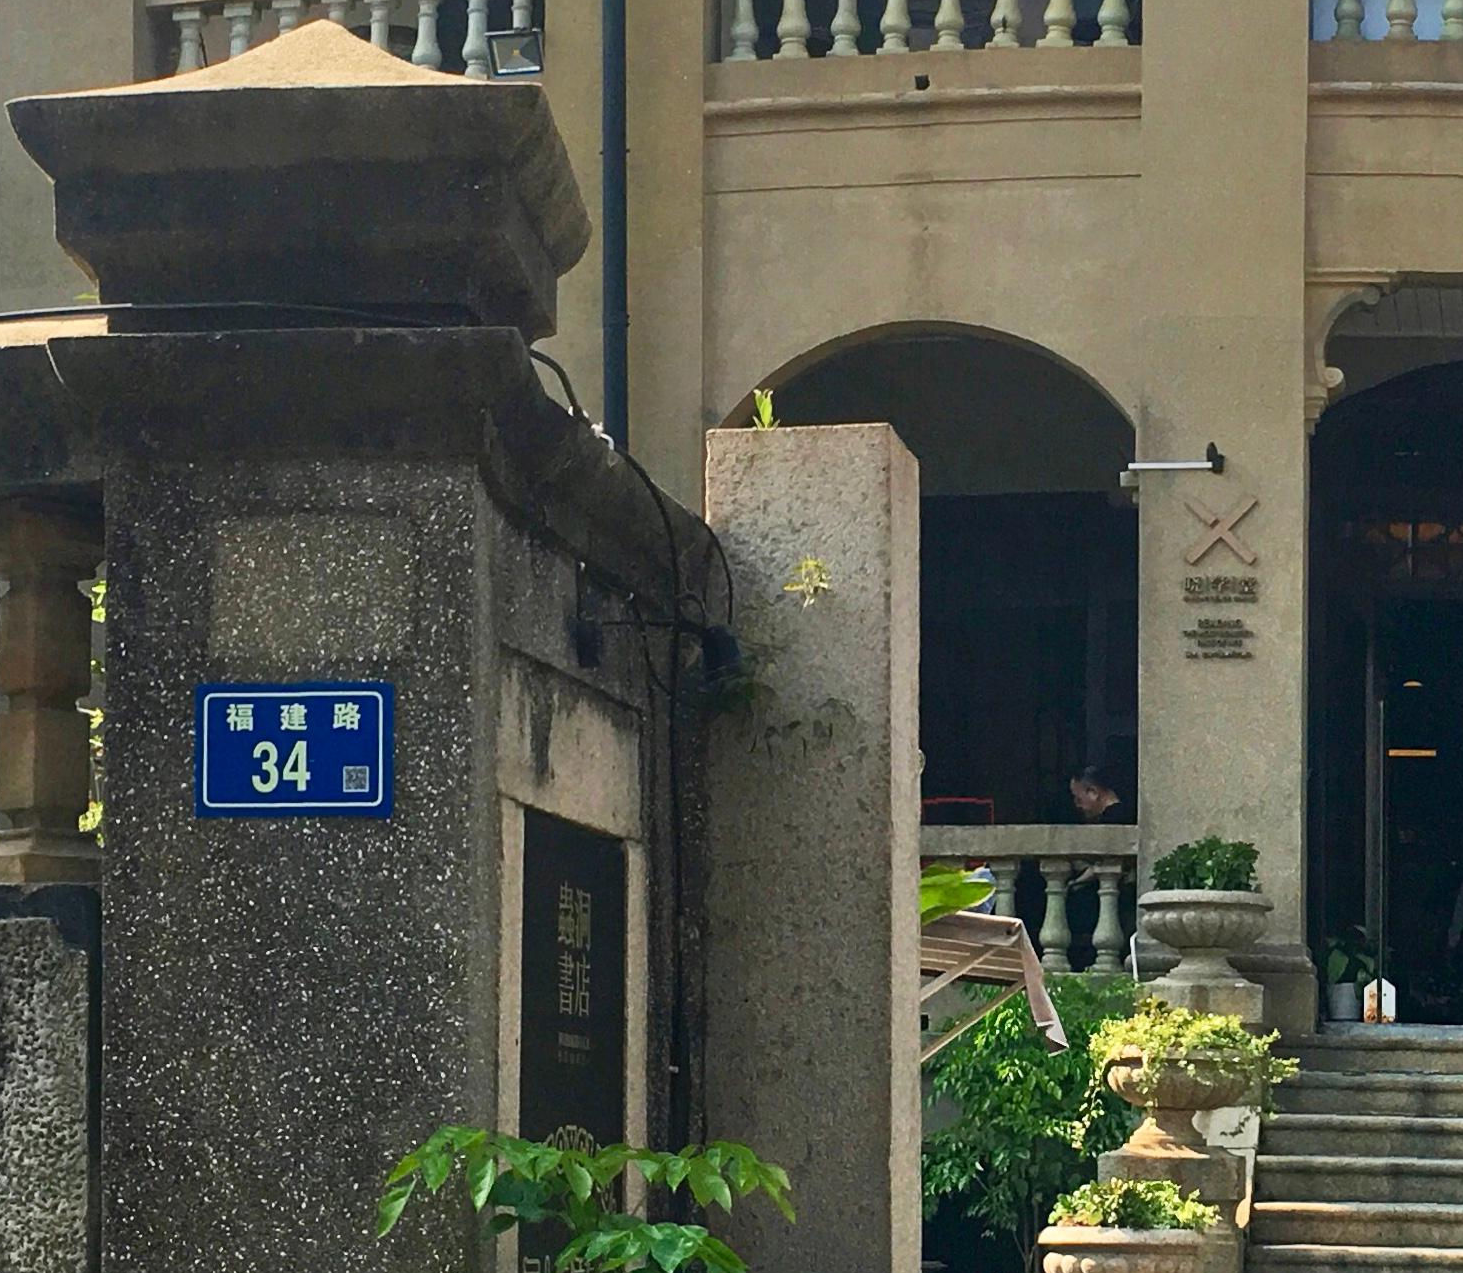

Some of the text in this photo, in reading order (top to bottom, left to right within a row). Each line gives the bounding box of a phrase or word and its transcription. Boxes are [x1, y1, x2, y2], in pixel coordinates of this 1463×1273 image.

[226, 702, 361, 732] 福建路
[252, 740, 311, 793] 34
